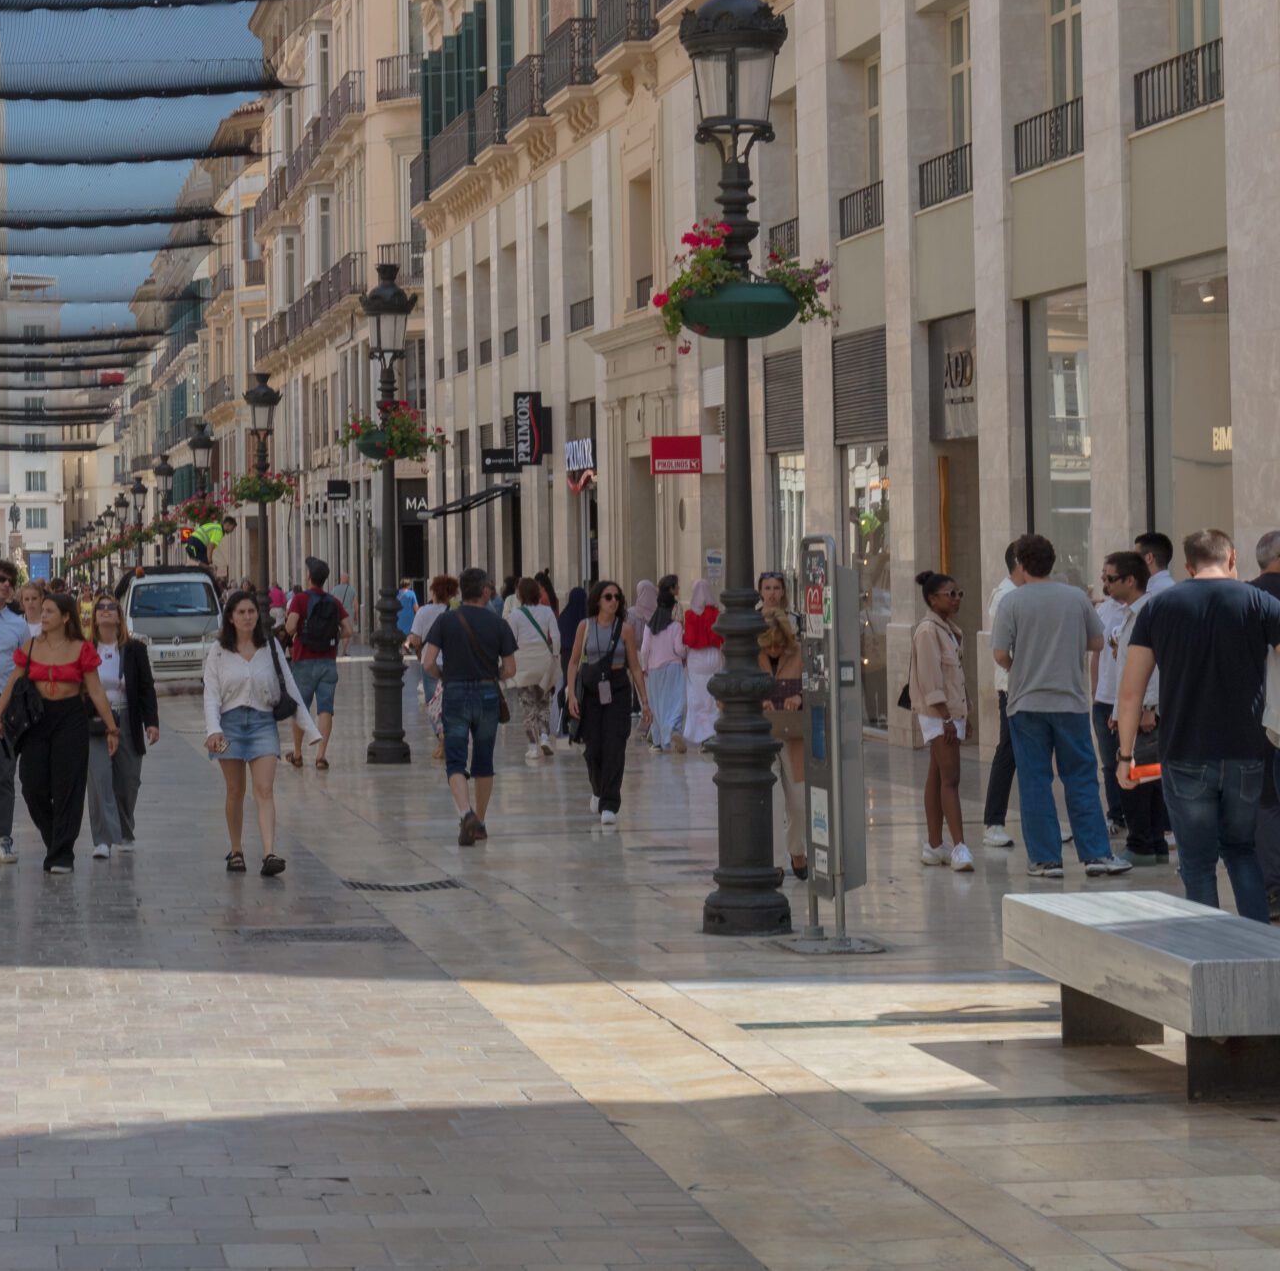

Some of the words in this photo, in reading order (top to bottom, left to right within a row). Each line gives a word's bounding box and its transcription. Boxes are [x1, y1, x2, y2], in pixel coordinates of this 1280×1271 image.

[517, 395, 530, 463] PRIMOR
[1212, 426, 1232, 451] BIM
[565, 437, 594, 471] PRIMOR
[405, 497, 428, 511] MA
